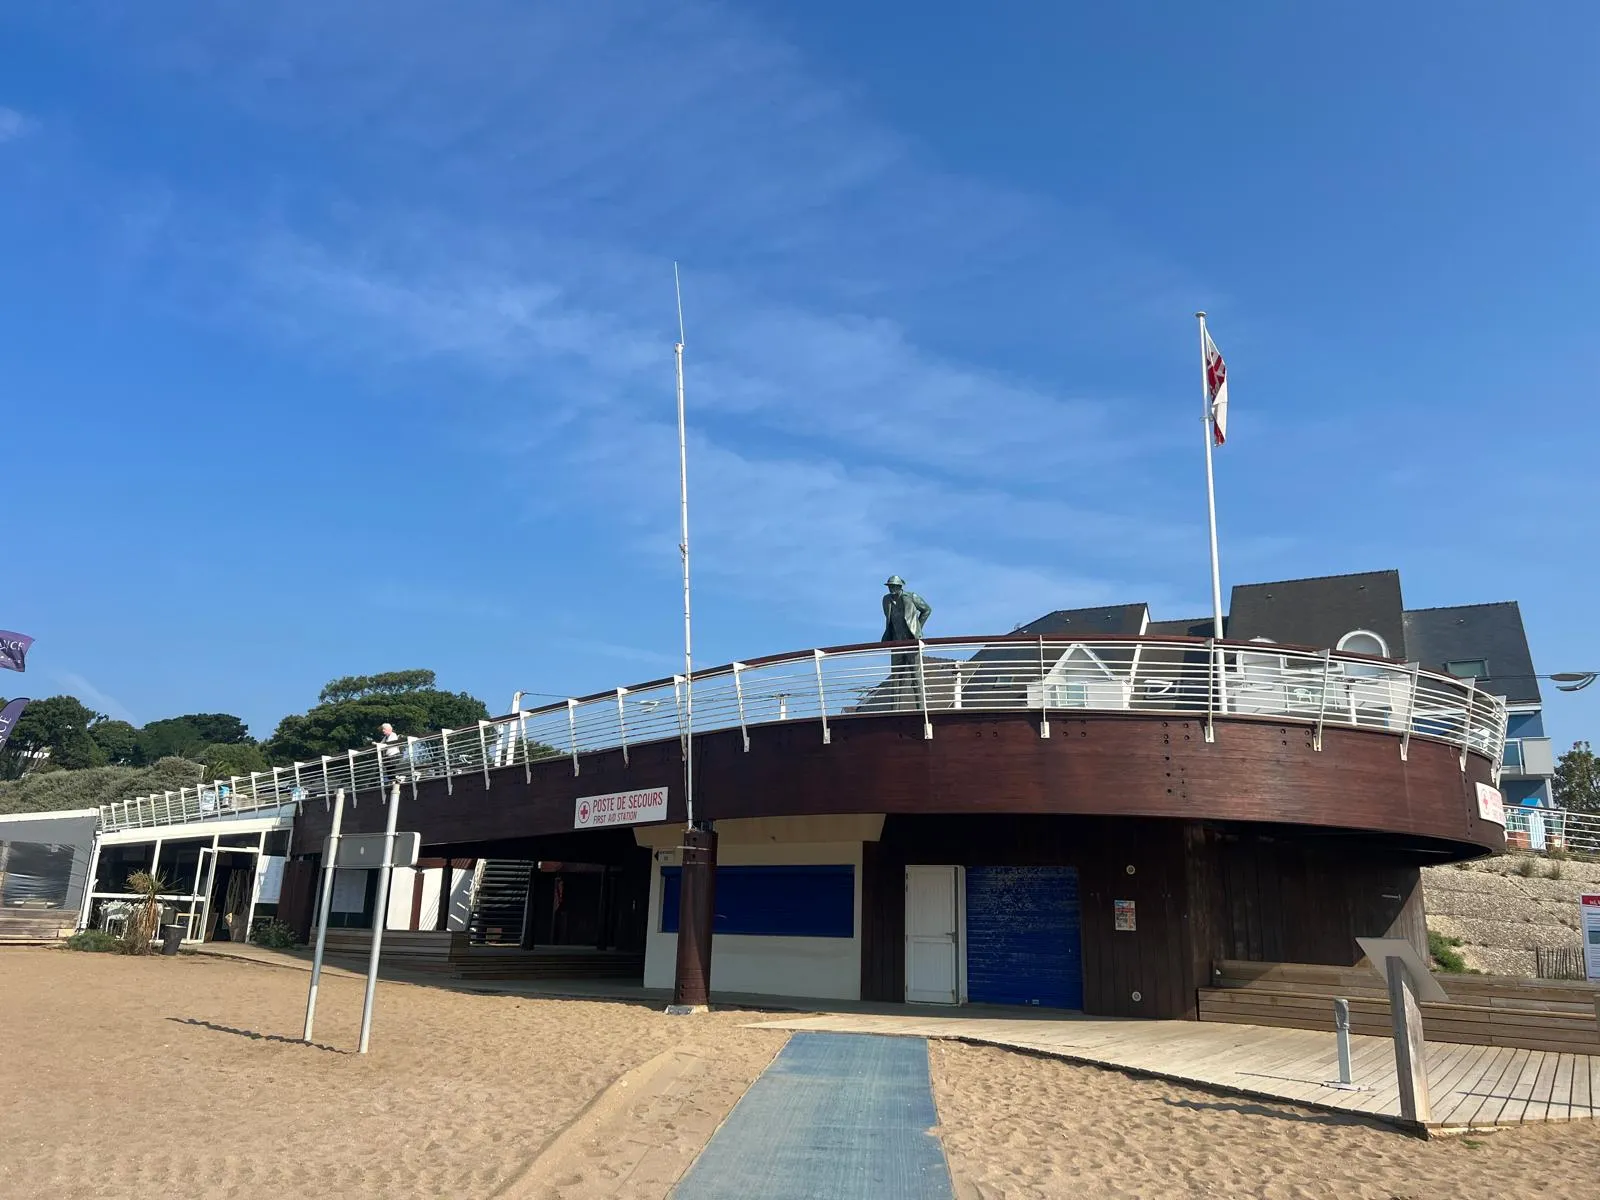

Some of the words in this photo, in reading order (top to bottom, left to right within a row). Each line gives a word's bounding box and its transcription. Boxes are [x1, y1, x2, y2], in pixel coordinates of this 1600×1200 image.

[593, 798, 614, 813] POSTE
[616, 796, 626, 810] DE
[628, 792, 662, 808] SECOURS
[593, 815, 606, 824] FIRST
[608, 813, 616, 822] AID
[617, 811, 637, 822] STATION
